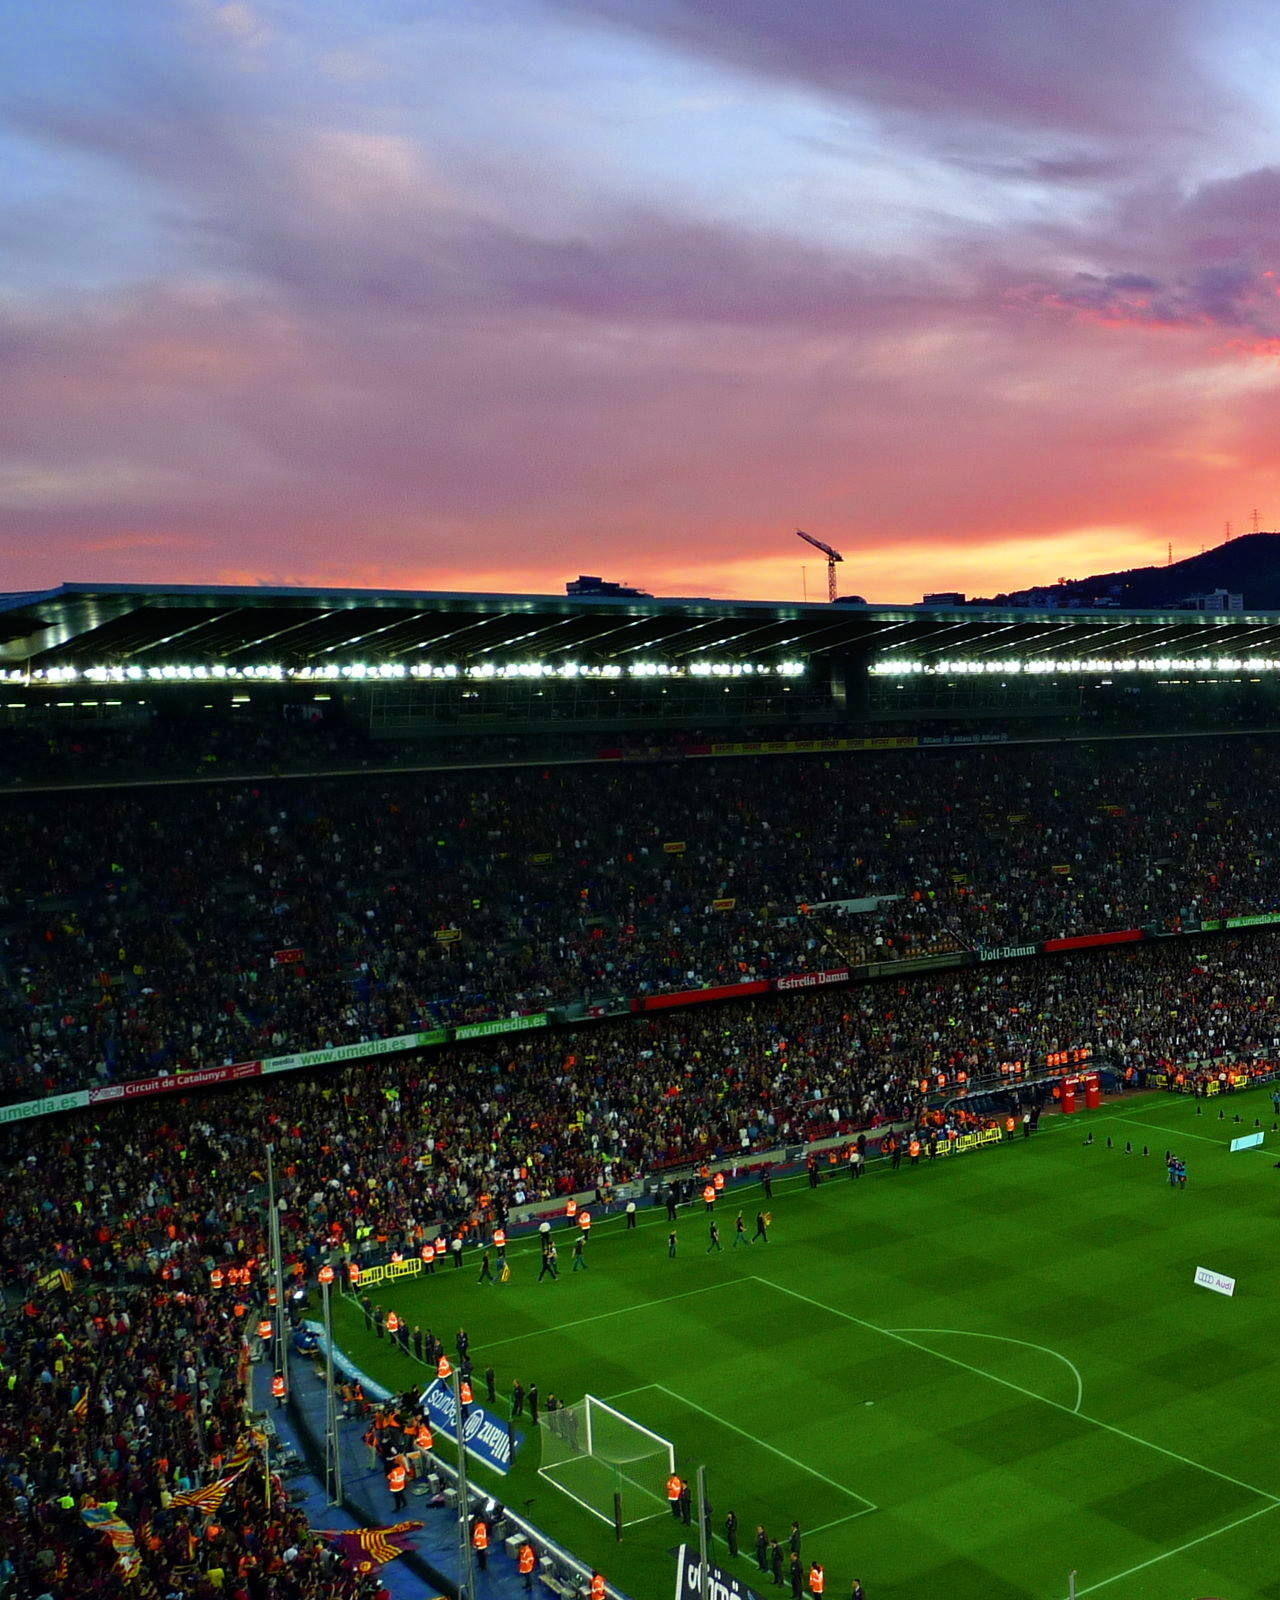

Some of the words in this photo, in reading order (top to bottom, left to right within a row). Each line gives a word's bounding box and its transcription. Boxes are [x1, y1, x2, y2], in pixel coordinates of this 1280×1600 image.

[980, 946, 1036, 960] Voll-Damm
[777, 978, 816, 989] Estrella
[818, 972, 849, 984] Damm
[300, 1038, 407, 1065] www.umedia.es
[125, 1081, 159, 1094] Circuit
[162, 1079, 175, 1088] de
[177, 1070, 227, 1086] Catalunya
[1215, 1279, 1232, 1291] Audi
